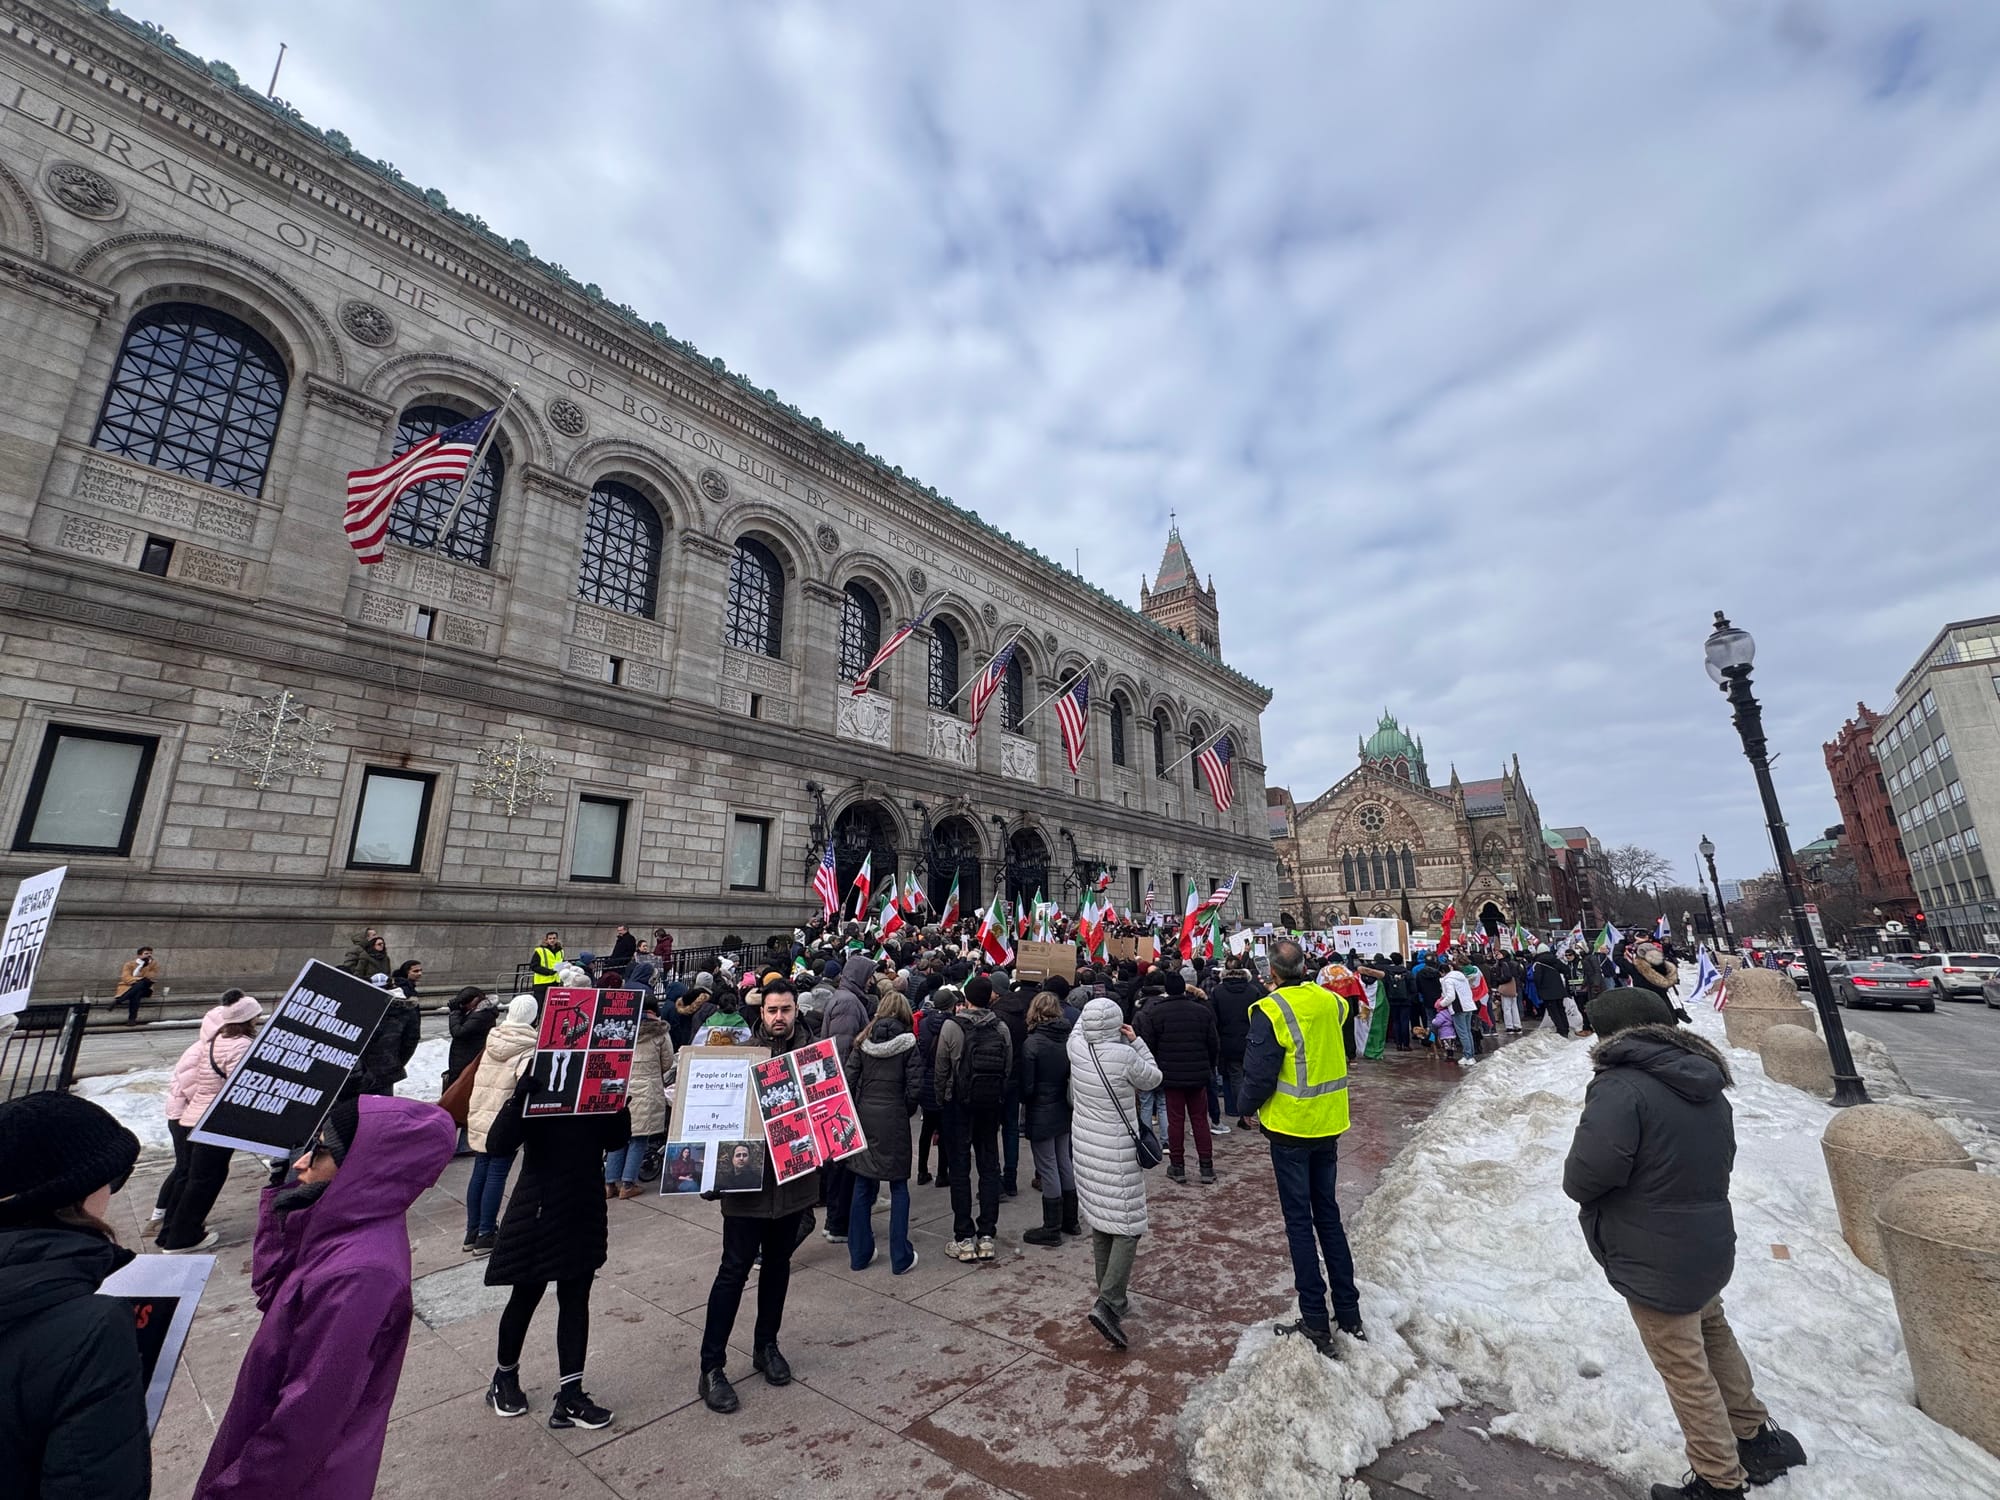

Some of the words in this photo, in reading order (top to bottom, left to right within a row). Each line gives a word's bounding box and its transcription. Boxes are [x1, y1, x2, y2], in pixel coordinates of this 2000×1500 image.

[13, 86, 245, 214] LIBRARY
[277, 222, 335, 258] OF
[370, 266, 440, 317] THE
[464, 318, 543, 365] CITY
[568, 369, 606, 395] OF
[622, 395, 724, 459] BOSTON
[738, 455, 793, 493] BUILT
[807, 488, 831, 509] BY
[843, 507, 878, 537] THE
[888, 530, 941, 569] PEOPLE
[950, 564, 977, 585] AND
[986, 580, 1048, 622] DEDICATED
[1055, 615, 1069, 632] TO
[1074, 625, 1091, 643] THE
[87, 458, 133, 476] PINDAR
[81, 481, 139, 502] XENOPHON
[84, 472, 126, 491] VIRGIL
[64, 532, 119, 551] PERICLES
[18, 903, 30, 916] WE
[30, 899, 51, 913] WANT
[21, 890, 43, 906] WHAT
[43, 887, 55, 901] DO
[4, 917, 48, 956] FREE
[1355, 929, 1374, 937] Free
[0, 947, 38, 996] IRAN
[292, 987, 315, 1007] NO
[312, 993, 342, 1016] DEAL
[283, 1002, 318, 1026] WITH
[315, 1017, 363, 1042] MULLAH
[253, 1042, 286, 1064] FOR
[279, 1050, 315, 1073] IRAN
[264, 1027, 316, 1055] REGIME
[310, 1042, 359, 1070] CHANGE
[234, 1069, 275, 1093] REZA
[268, 1078, 324, 1106] PAHLAVI
[705, 1082, 724, 1090] being
[224, 1085, 256, 1108] FOR
[252, 1093, 289, 1115] IRAN
[712, 1122, 739, 1130] Republic
